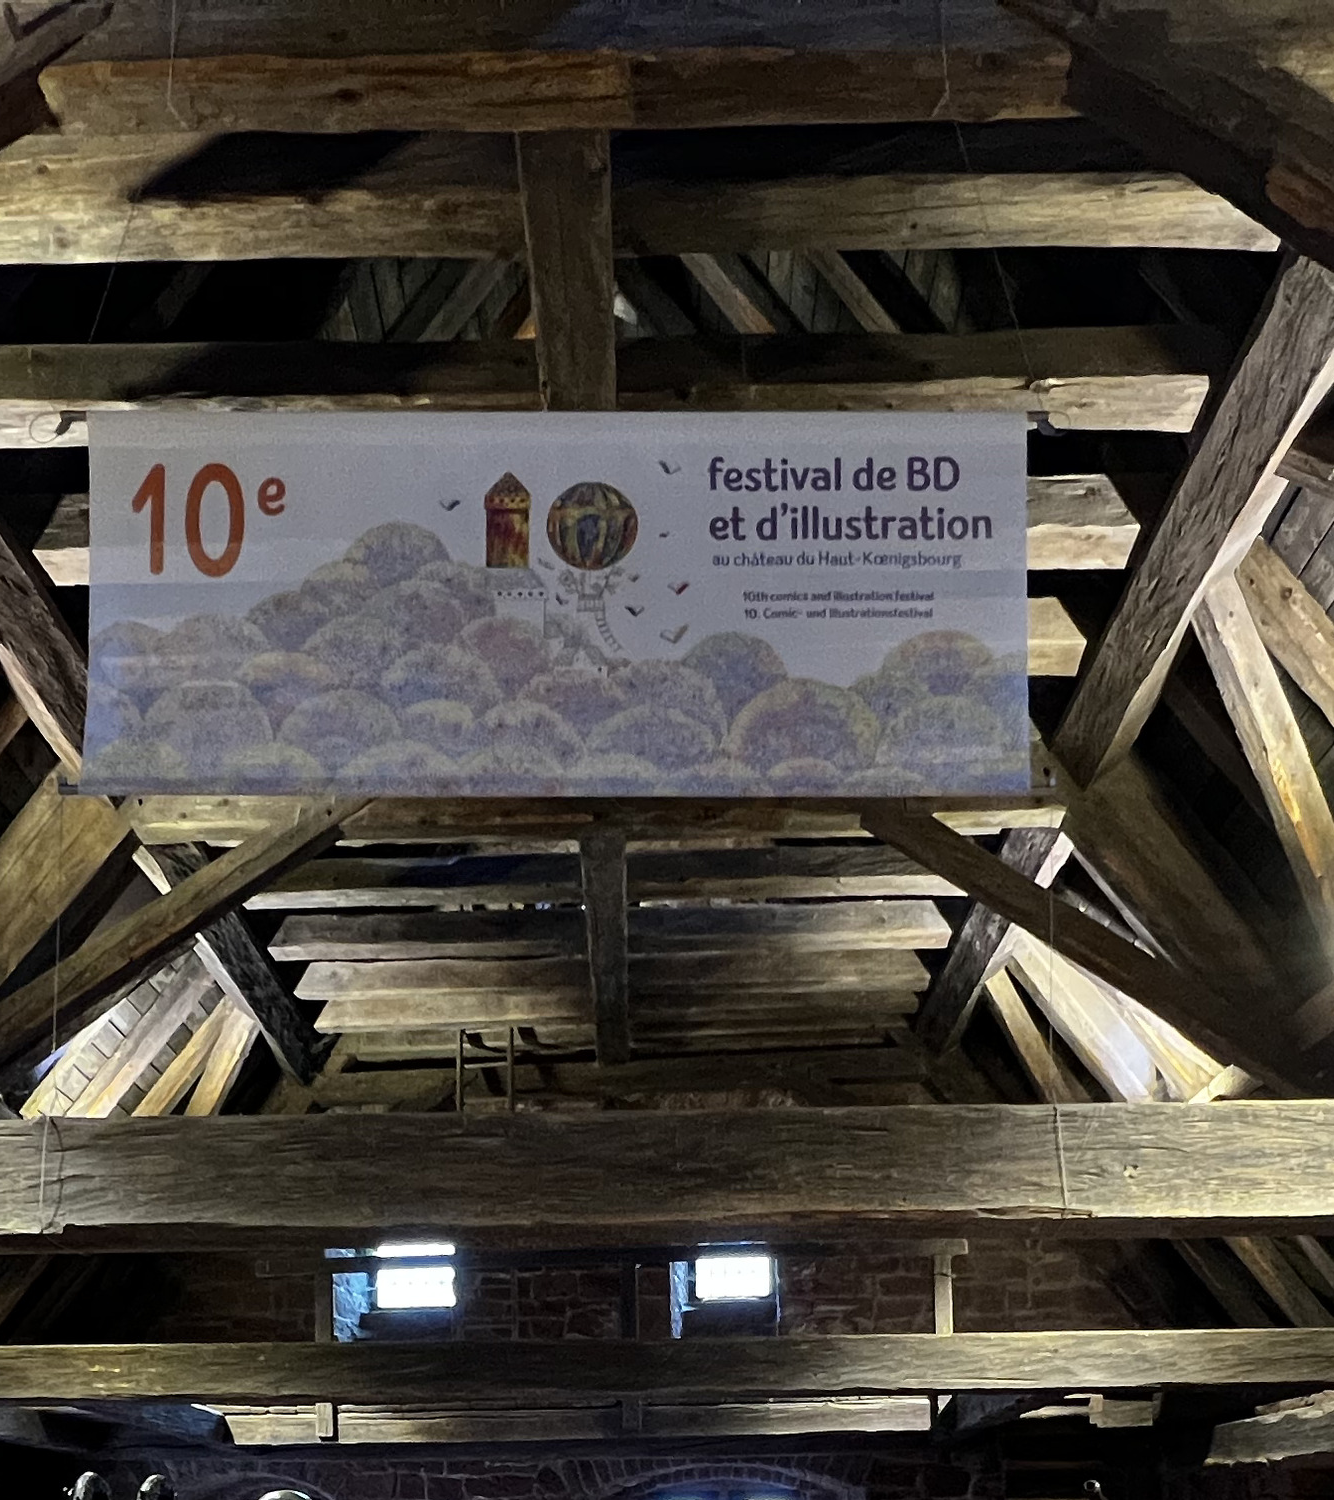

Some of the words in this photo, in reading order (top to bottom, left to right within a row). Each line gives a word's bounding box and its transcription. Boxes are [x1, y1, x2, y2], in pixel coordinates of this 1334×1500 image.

[708, 456, 842, 492] festival
[852, 456, 897, 492] de
[907, 456, 960, 492] BD
[709, 506, 746, 541] et
[756, 502, 993, 541] d'illustration
[712, 554, 730, 567] au
[733, 551, 793, 567] château
[796, 551, 815, 567] du
[818, 551, 962, 569] Haut-Kœnigsbourg
[742, 591, 768, 602] 10th
[770, 591, 809, 602] comics
[811, 591, 832, 602] and
[895, 590, 935, 602] festival
[806, 608, 827, 619] und
